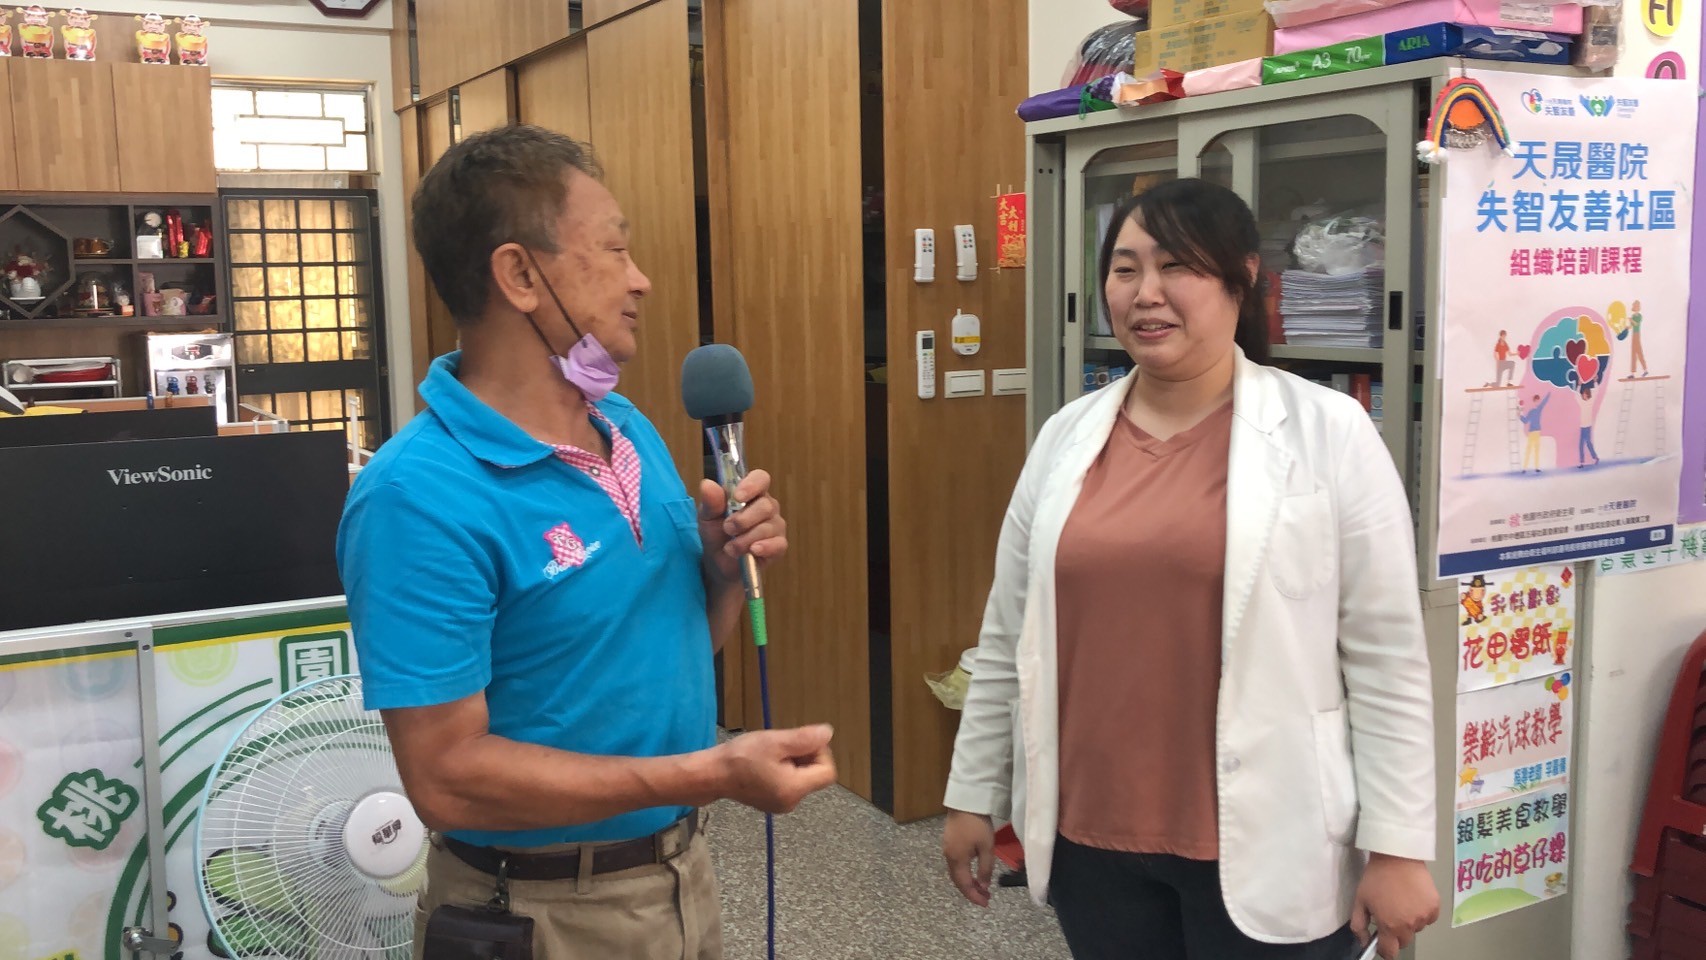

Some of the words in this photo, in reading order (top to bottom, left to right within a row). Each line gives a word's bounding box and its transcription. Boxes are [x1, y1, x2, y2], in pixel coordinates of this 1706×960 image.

[1312, 52, 1332, 70] A3
[1512, 141, 1649, 180] 天晟醫院
[1476, 189, 1677, 233] 失智友善社區
[1509, 246, 1643, 276] 組織培訓課程
[107, 464, 213, 485] ViewSonic
[285, 637, 346, 699] 園
[42, 772, 135, 847] 桃
[1457, 793, 1567, 844] 銀髮美食教學
[1457, 832, 1566, 892] 好吃的草仔粿
